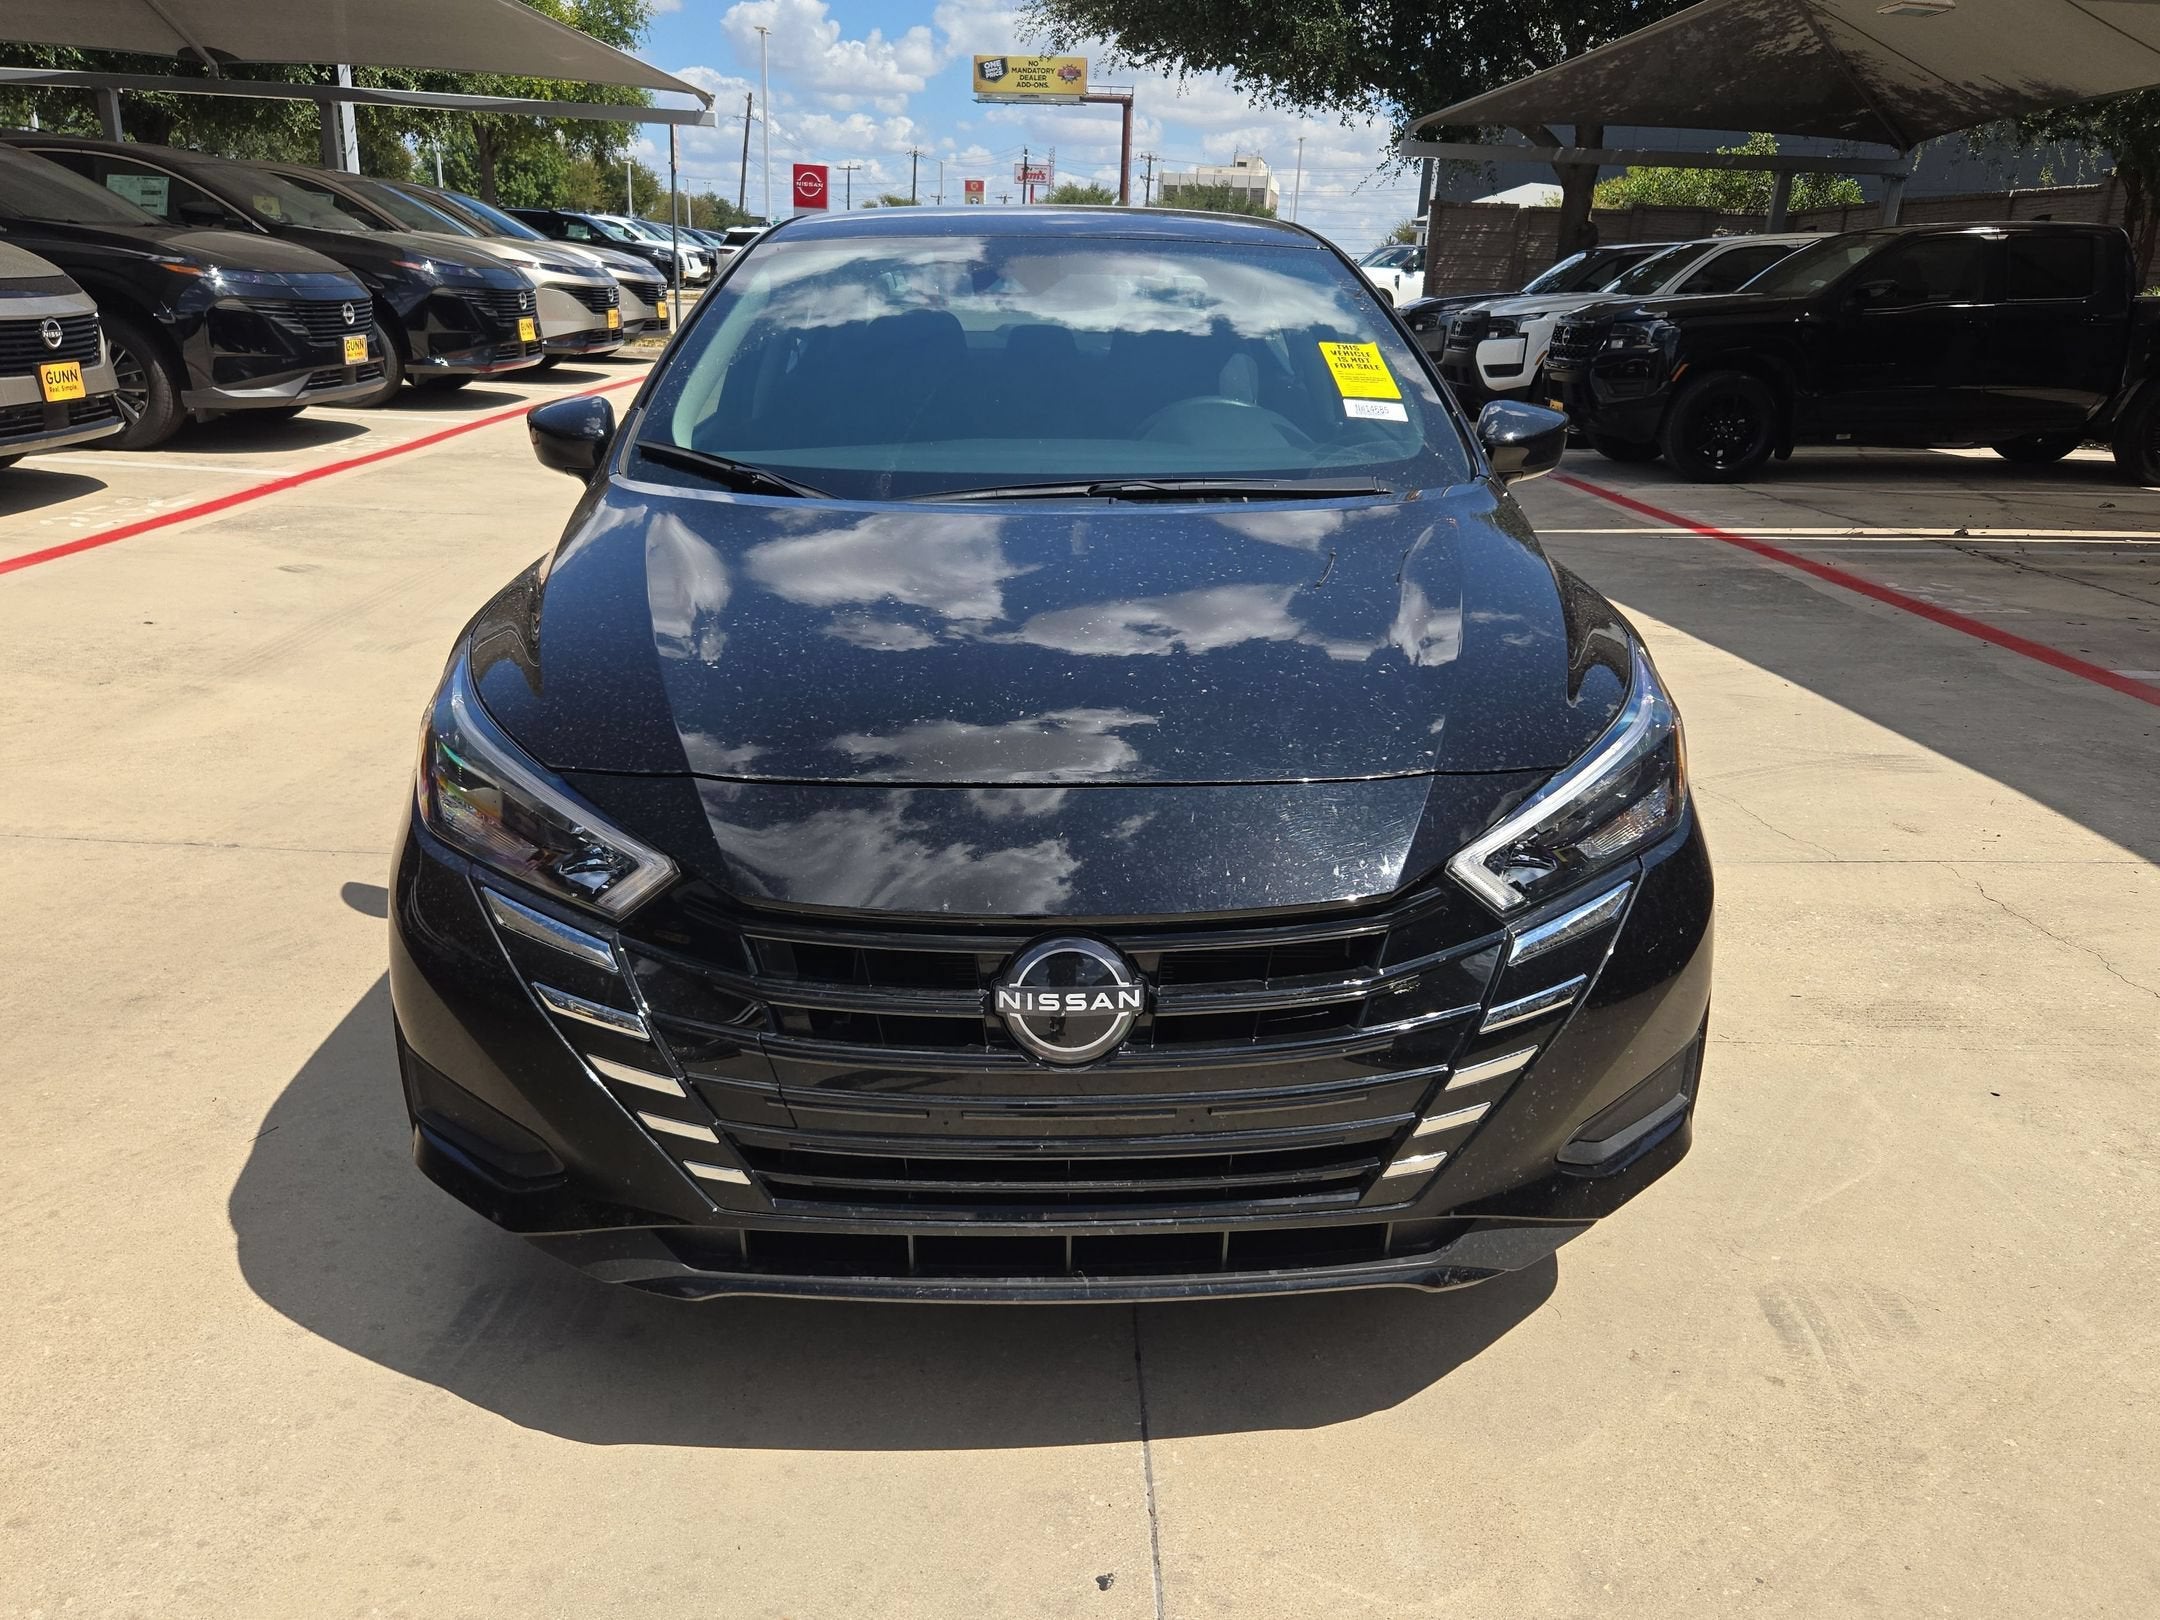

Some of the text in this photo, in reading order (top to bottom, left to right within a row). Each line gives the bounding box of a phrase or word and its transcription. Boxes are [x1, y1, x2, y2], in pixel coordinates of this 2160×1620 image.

[984, 60, 1001, 69] ONE
[985, 70, 1003, 78] PRICE
[1011, 67, 1055, 75] MANDATORY
[345, 339, 364, 351] GUNN
[46, 369, 78, 384] GUNN
[999, 989, 1140, 1011] NISSAN
